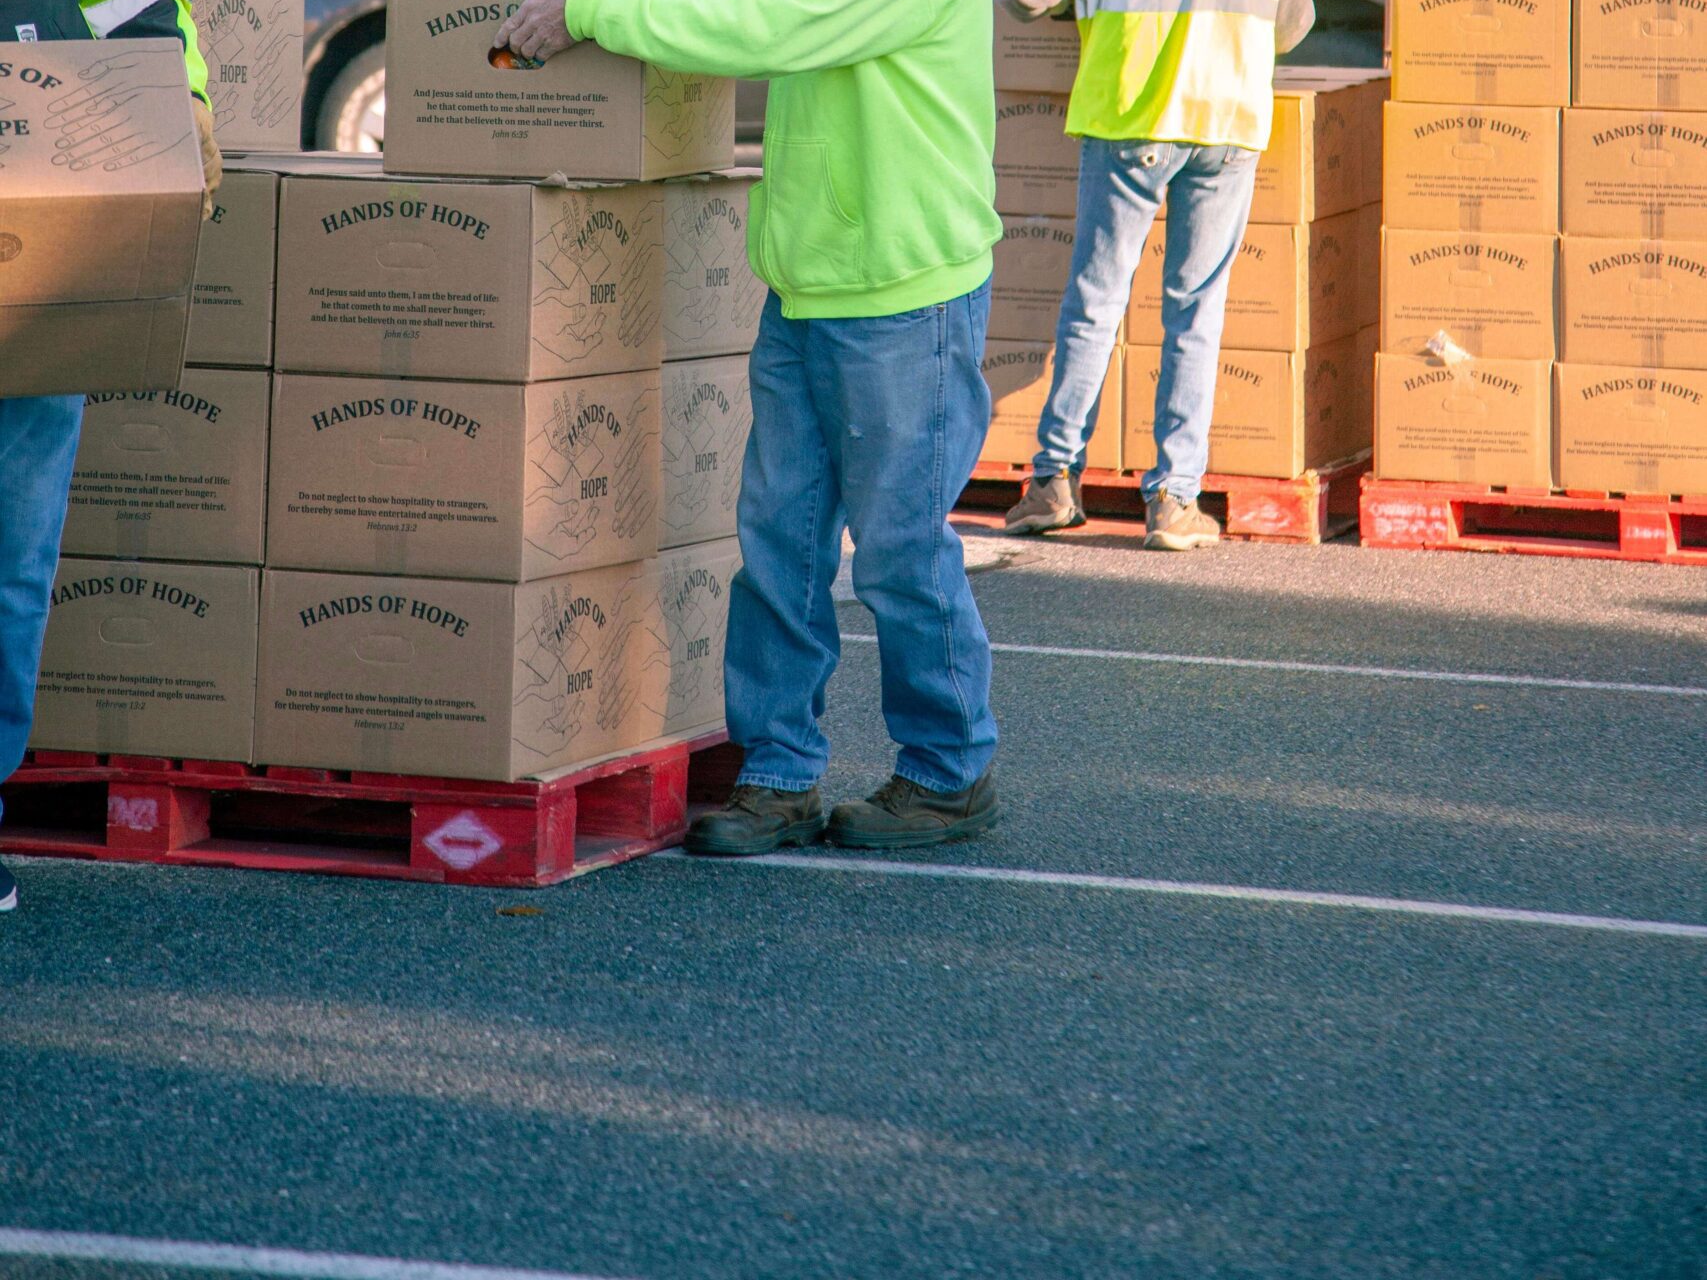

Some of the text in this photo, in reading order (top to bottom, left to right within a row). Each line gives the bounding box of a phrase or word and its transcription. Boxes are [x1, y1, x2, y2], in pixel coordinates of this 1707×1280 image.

[246, 8, 261, 33] OF
[425, 4, 500, 37] HANDS
[20, 68, 62, 90] OF
[220, 65, 247, 83] HOPE
[413, 89, 430, 97] And
[432, 90, 454, 100] Jesus
[455, 90, 473, 98] said
[474, 91, 494, 99] unto
[495, 91, 519, 101] them,
[521, 92, 524, 100] I
[541, 92, 554, 100] the
[556, 93, 580, 101] bread
[582, 93, 591, 101] of
[592, 94, 608, 102] life:
[684, 83, 702, 102] HOPE
[427, 102, 437, 110] he
[439, 103, 456, 111] that
[458, 103, 489, 112] cometh
[490, 104, 499, 112] to
[515, 105, 535, 113] shall
[562, 106, 595, 117] hunger;
[996, 104, 1056, 121] ANDS OF
[416, 115, 432, 123] and
[434, 115, 445, 123] he
[446, 116, 463, 124] that
[464, 116, 503, 125] believeth
[532, 118, 552, 126] shall
[579, 119, 605, 128] thirst.
[1414, 116, 1531, 143] HANDS OF HOPE
[492, 130, 509, 139] John
[1592, 123, 1644, 146] HANDS
[1648, 124, 1668, 136] OF
[321, 201, 490, 240] HANDS OF HOPE
[695, 198, 741, 237] HANDS OF
[576, 210, 629, 251] HANDS OF
[1410, 245, 1528, 271] HANDS OF HOPE
[1589, 252, 1707, 278] HANDS OF HOPE
[706, 268, 728, 287] HOPE
[590, 284, 616, 304] HOPE
[1223, 365, 1263, 387] HOPE
[1404, 371, 1523, 396] HANDS HOPE
[683, 383, 730, 423] HANDS OF
[1582, 379, 1703, 405] HANDS OF HOPE
[165, 390, 221, 423] HOPE
[311, 399, 481, 439] HANDS OF HOPE
[568, 404, 622, 447] HANDS OF
[695, 451, 718, 472] HOPE
[581, 476, 607, 499] HOPE
[298, 492, 488, 510] Do not neglect to show hospitality to strangers,
[287, 504, 300, 513] for
[301, 505, 332, 516] thereby
[358, 508, 377, 516] have
[379, 509, 426, 519] entertained
[428, 511, 455, 522] angels
[367, 522, 417, 532] Hebrews 13:2
[120, 577, 147, 595] OF
[152, 582, 210, 618] HOPE
[676, 569, 721, 612] HANDS OF
[299, 596, 469, 637] HANDS OF HOPE
[555, 597, 606, 643] HANDS OF
[687, 637, 710, 660] HOPE
[567, 669, 593, 695] HOPE
[285, 688, 476, 709] Do not neglect to show hospitality to strangers,
[275, 701, 287, 709] for
[288, 701, 320, 713] thereby
[345, 705, 364, 714] have
[366, 706, 414, 717] entertained
[416, 709, 443, 720] angels
[444, 713, 487, 721] unawares.
[354, 720, 404, 730] Hebrews 13:2
